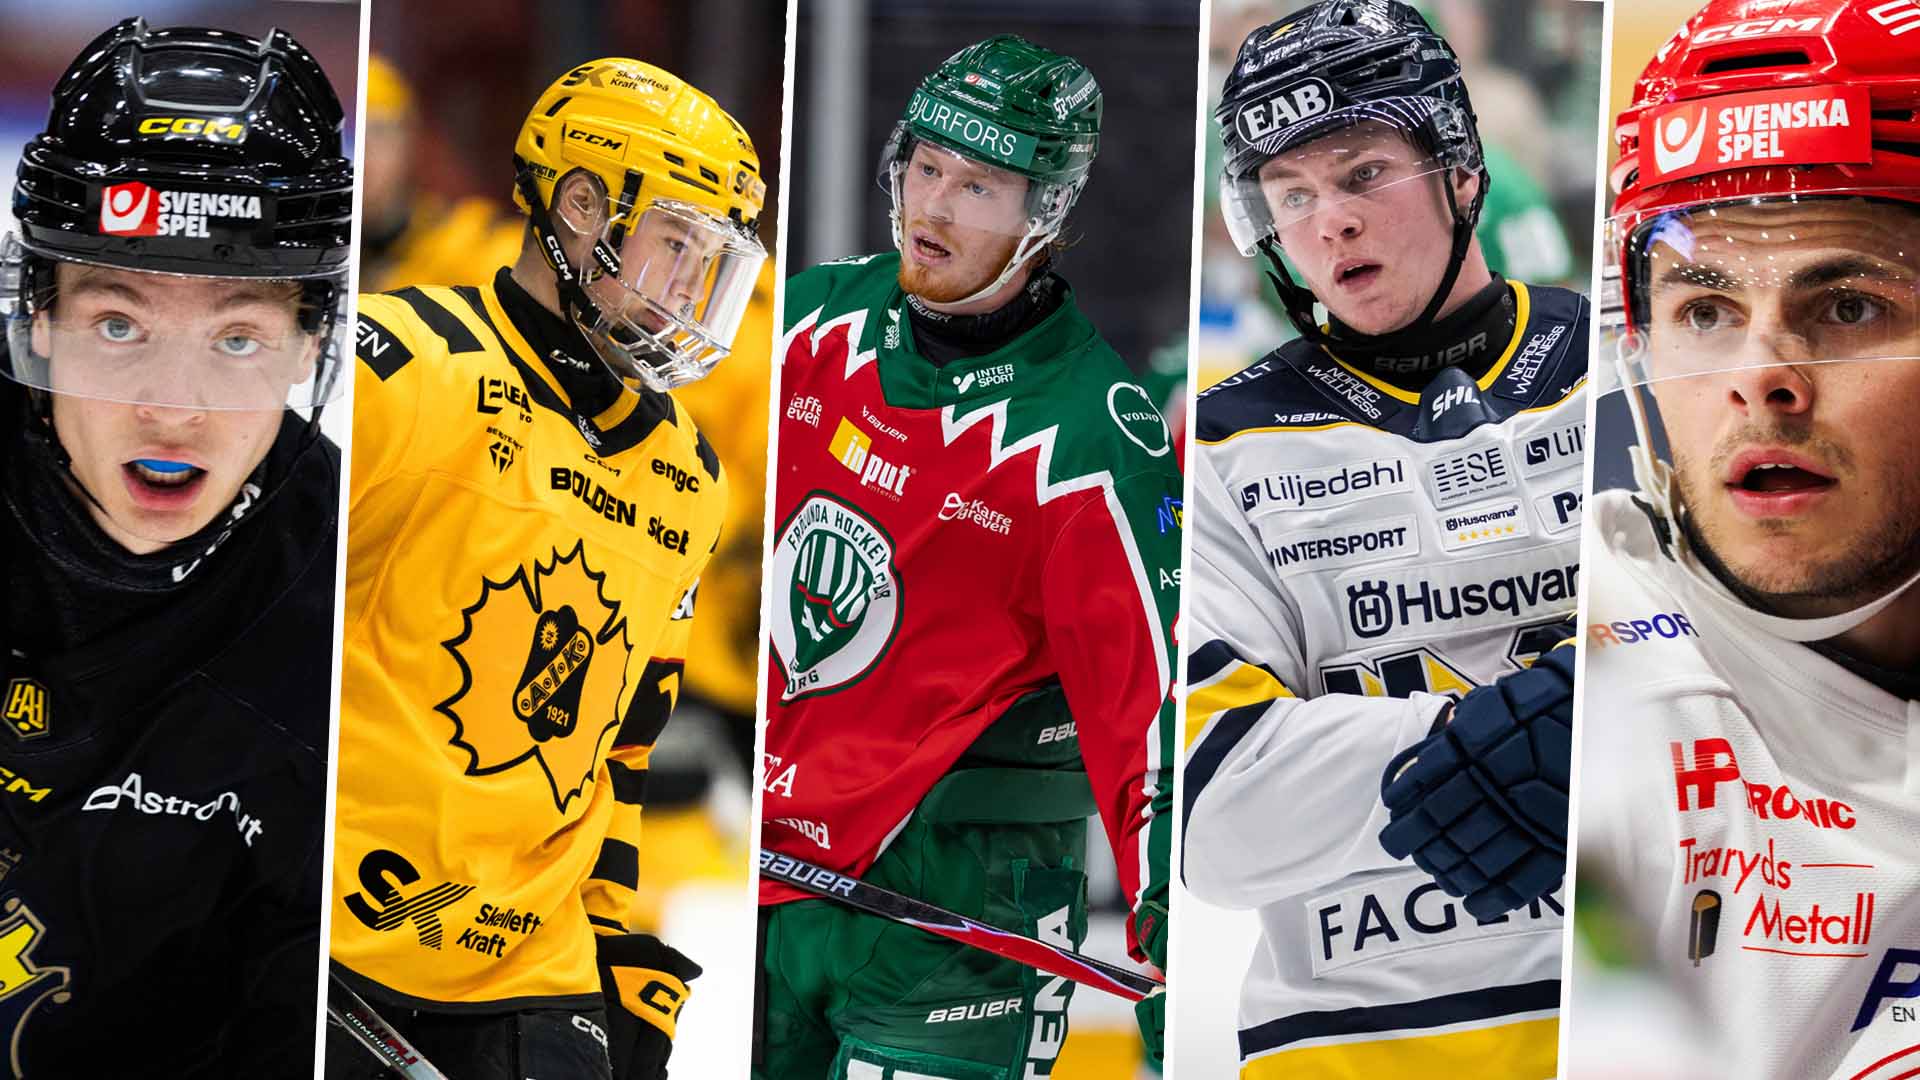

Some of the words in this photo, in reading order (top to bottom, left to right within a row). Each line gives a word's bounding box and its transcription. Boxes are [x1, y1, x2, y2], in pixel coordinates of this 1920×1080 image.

[1692, 17, 1823, 43] CCM
[610, 78, 638, 90] Kraft
[138, 117, 245, 140] CCM
[909, 93, 1017, 156] BJURFORS
[1242, 84, 1326, 140] EAB
[1718, 99, 1849, 135] SVENSKA
[568, 129, 623, 150] CCM
[1717, 131, 1785, 163] SPEL
[158, 190, 262, 219] SVENSKA
[156, 214, 210, 238] SPEL
[546, 235, 573, 280] CCM
[594, 246, 619, 273] CCM
[1375, 332, 1487, 373] BAUER
[1507, 334, 1545, 381] NORDIC
[1513, 325, 1566, 395] WELLNESS
[976, 364, 1014, 378] INTER
[978, 372, 1015, 388] SPORT
[1327, 367, 1380, 403] NORDIC
[790, 393, 823, 417] affe
[1308, 365, 1381, 420] WELLNESS
[1432, 385, 1481, 422] SHL
[867, 415, 909, 443] BAUER
[1120, 411, 1160, 423] VOLVO
[1289, 412, 1350, 424] BAUE
[584, 454, 621, 477] CCM
[841, 435, 911, 497] input
[1264, 460, 1404, 506] Liljedahl
[1434, 447, 1506, 493] HSE
[551, 467, 636, 527] BOLDEN
[1457, 508, 1516, 528] Husqvarna
[835, 510, 888, 567] HOCKEY
[1275, 527, 1407, 567] INTERSPORT
[1396, 563, 1579, 626] Husqvar
[545, 704, 570, 727] 1921
[1037, 721, 1078, 745] BAU
[1742, 778, 1857, 830] RONIC
[760, 849, 857, 897] BAUER
[1680, 837, 1792, 894] Traryds
[1319, 881, 1565, 960] FAGR
[1744, 893, 1875, 945] Metall
[456, 928, 506, 958] Kraft
[925, 998, 1023, 1024] BAUER
[572, 1015, 608, 1048] CC
